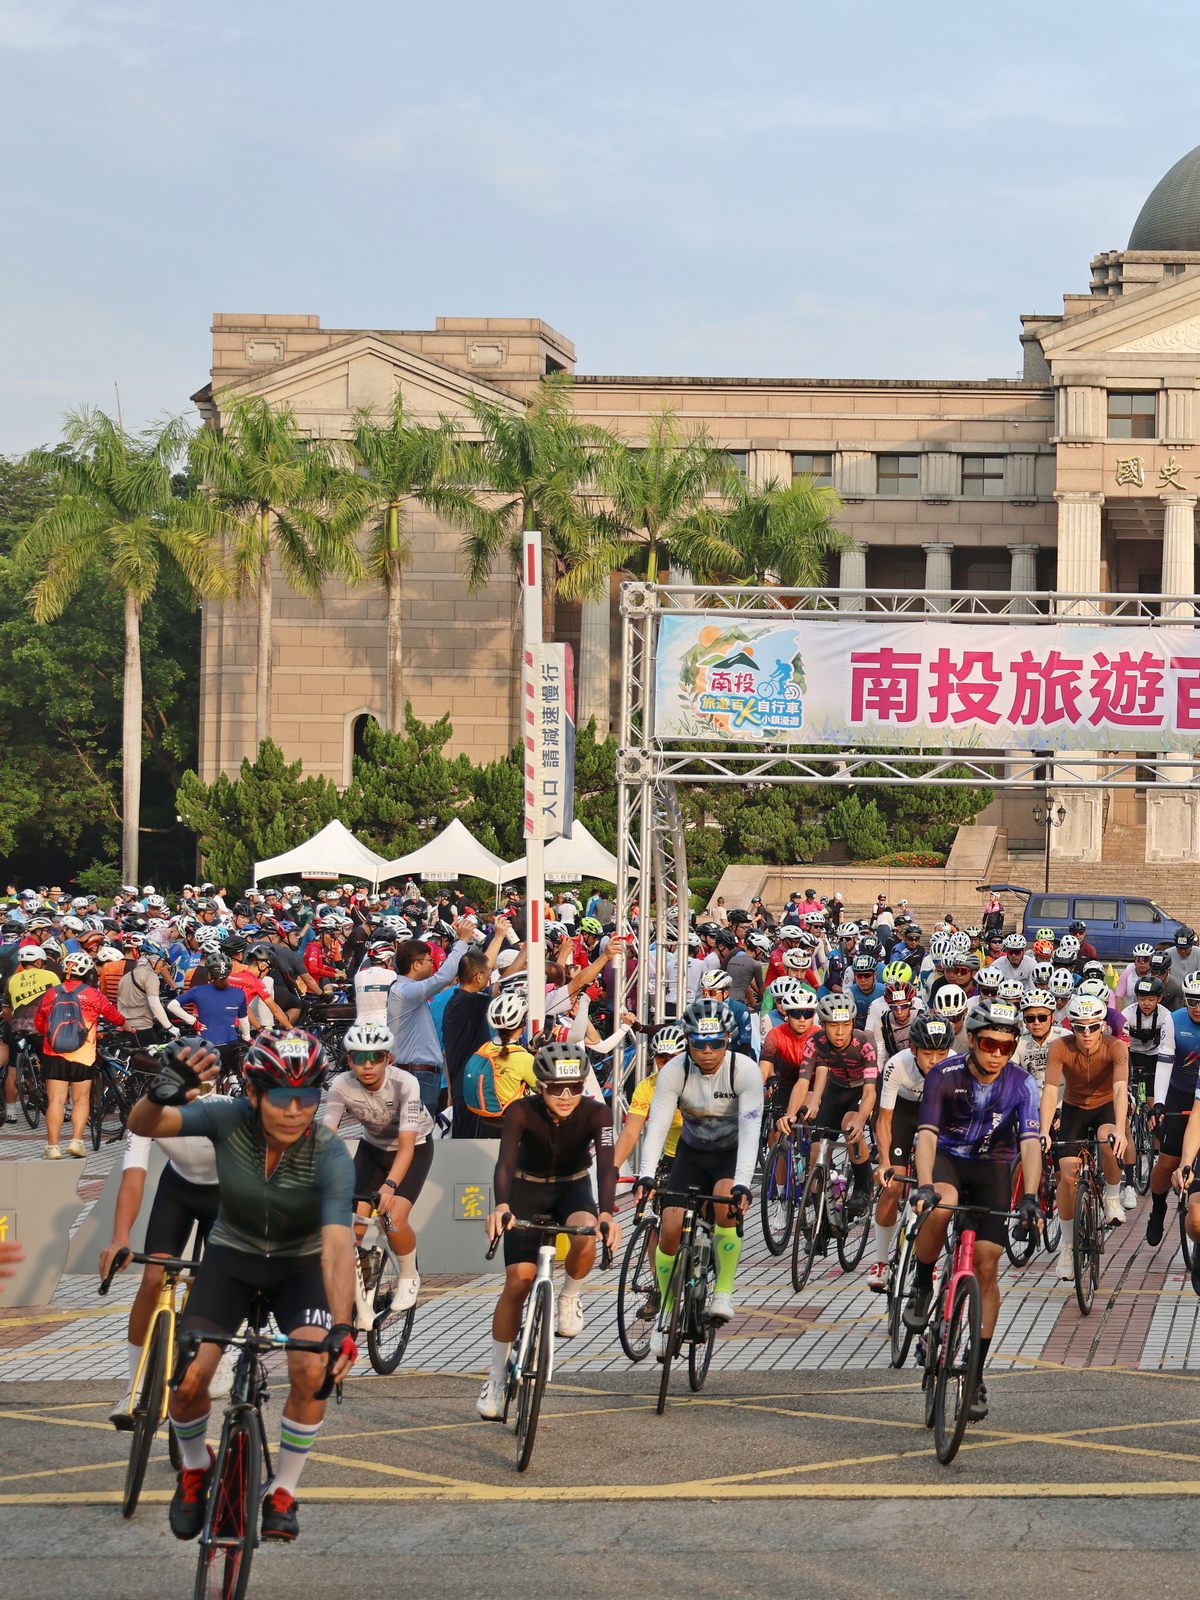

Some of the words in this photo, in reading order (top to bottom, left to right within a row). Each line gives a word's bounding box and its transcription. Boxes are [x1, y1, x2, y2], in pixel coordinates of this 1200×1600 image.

[710, 671, 756, 694] 南投
[542, 663, 560, 768] 請減速慢行
[542, 781, 559, 818] 入口
[993, 1007, 1014, 1018] 2267
